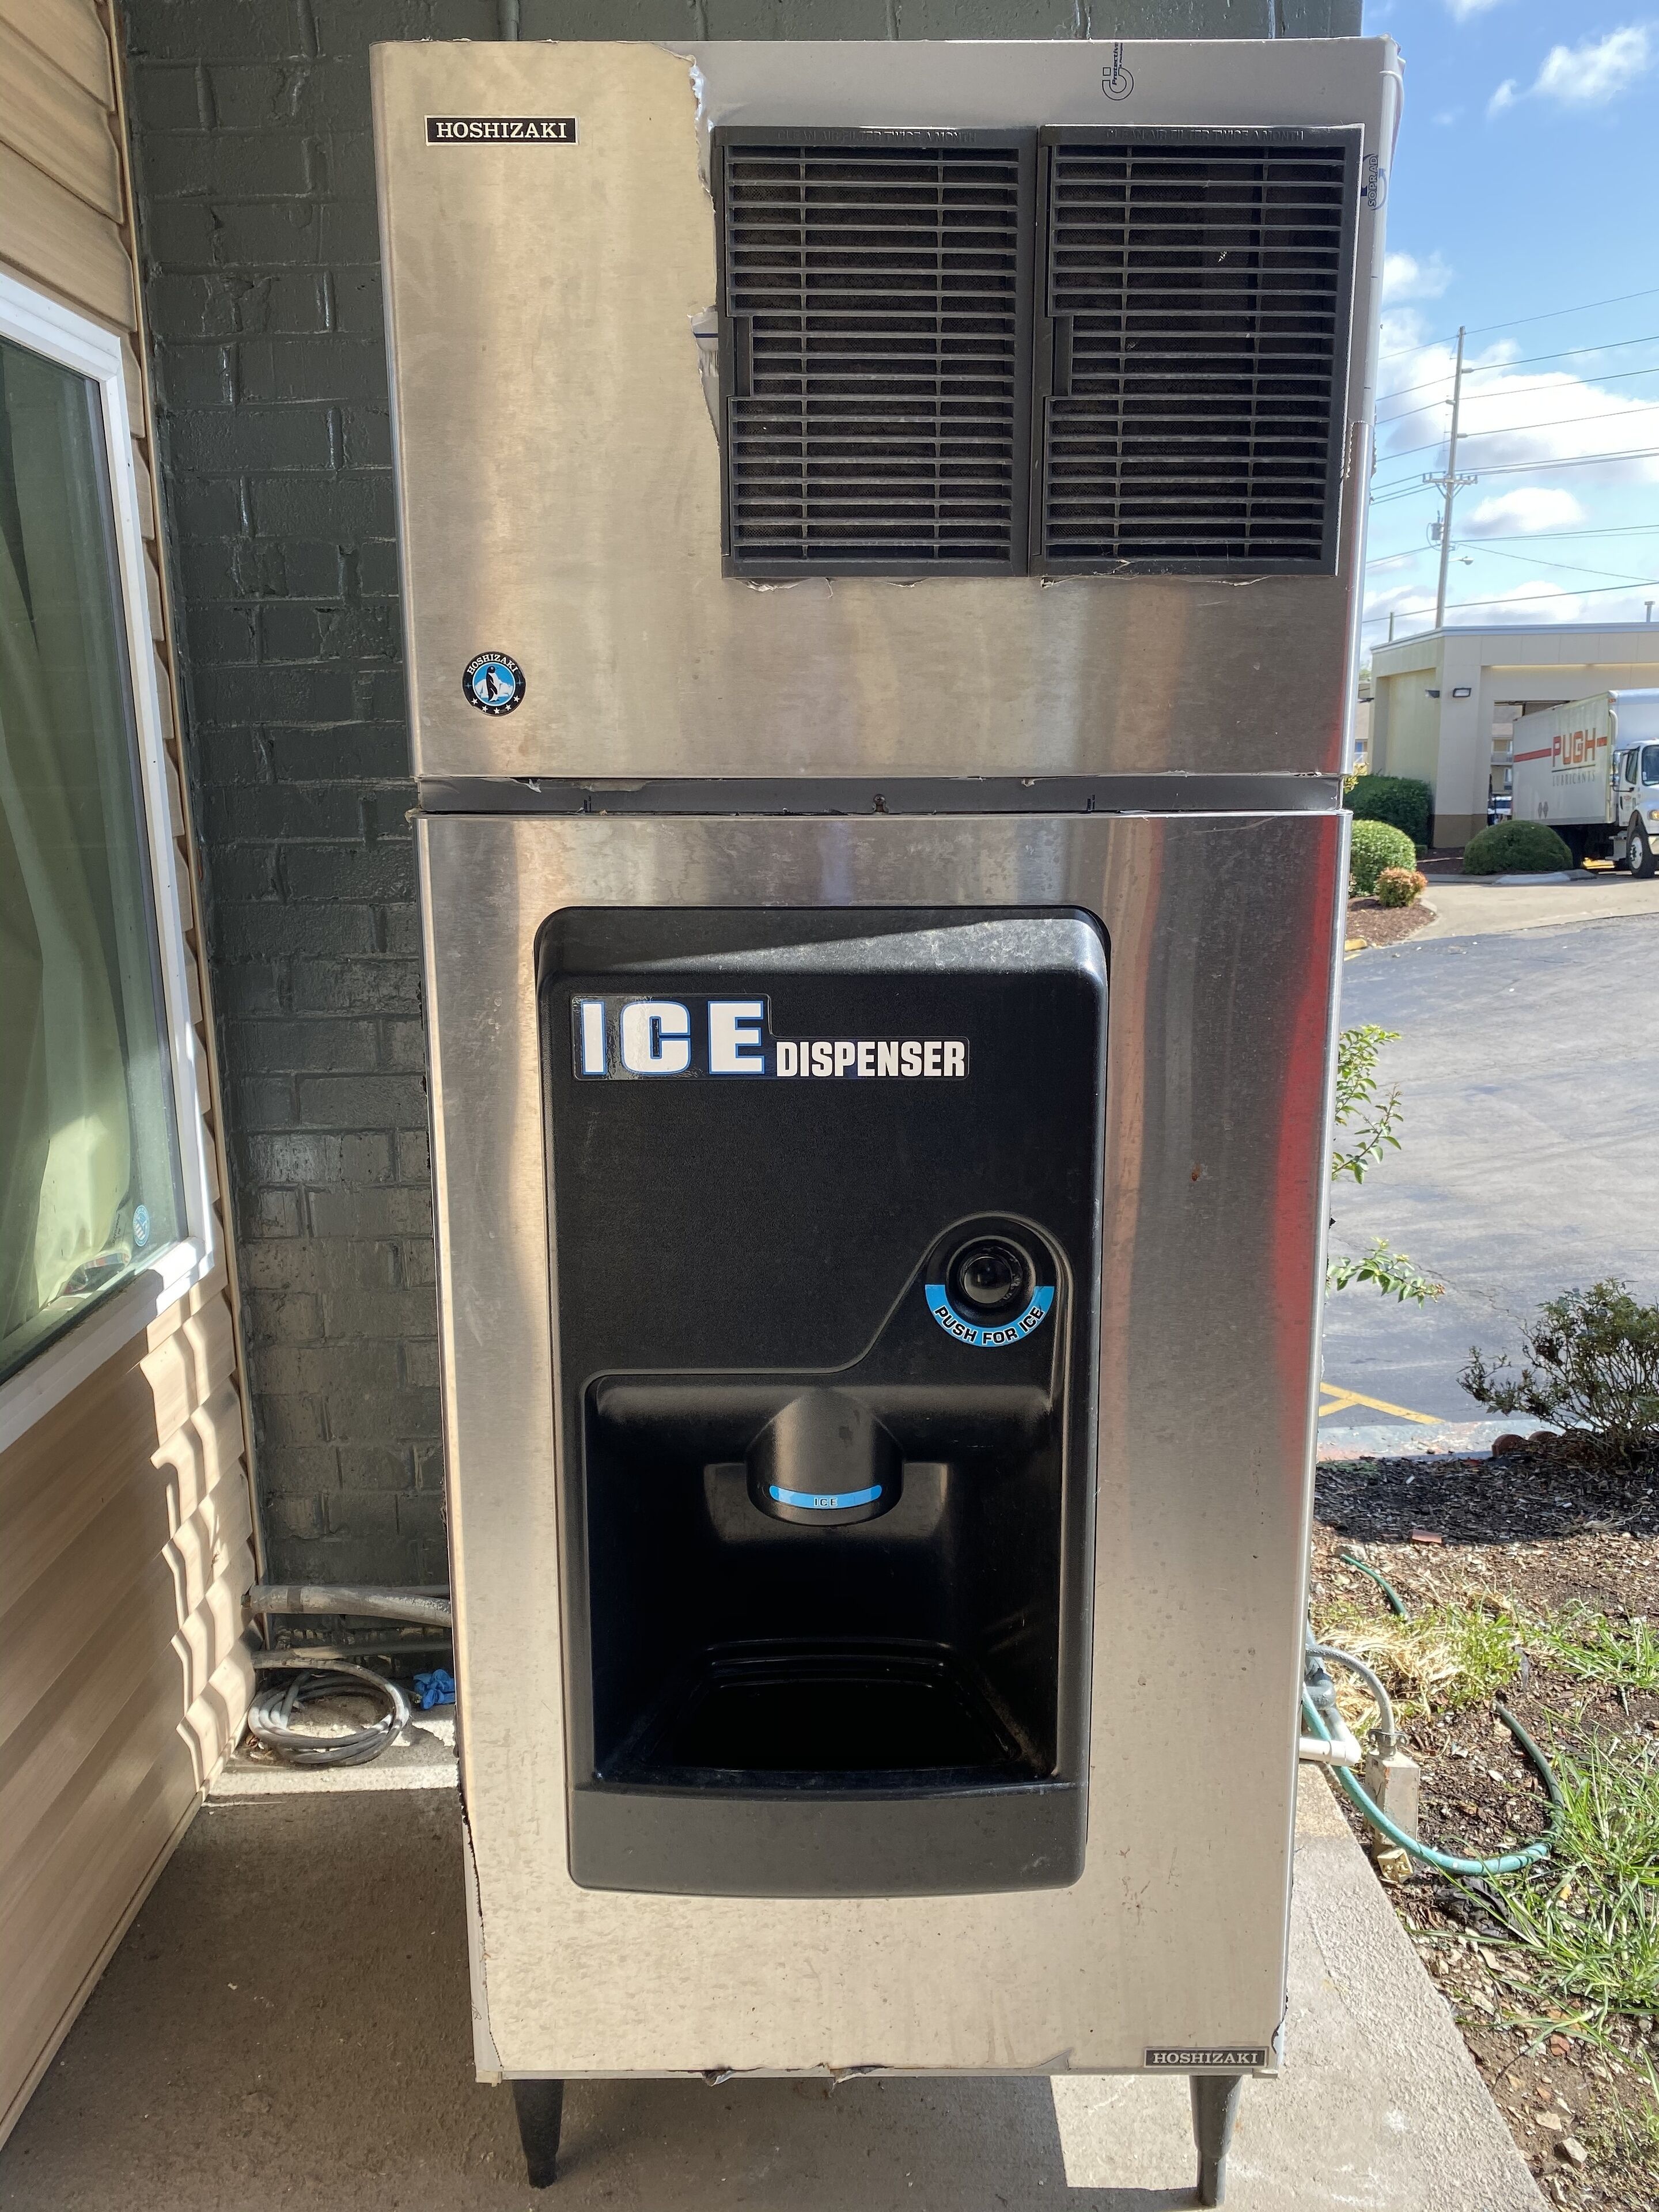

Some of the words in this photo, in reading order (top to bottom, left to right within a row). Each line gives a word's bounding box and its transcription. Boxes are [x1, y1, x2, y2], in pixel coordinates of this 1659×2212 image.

[435, 122, 567, 138] HOSHIZAKI
[1212, 130, 1249, 141] TWICE
[1263, 130, 1304, 141] MONTH
[467, 653, 518, 675] HOSHIZAKI
[1552, 728, 1596, 767] PUGH
[1552, 770, 1595, 787] LUBRICANTS
[582, 1000, 765, 1075] ICE
[776, 1041, 965, 1077] DISPENSER
[934, 1305, 978, 1343] PUSH
[982, 1327, 1018, 1346] FOR
[1018, 1306, 1046, 1334] ICE
[813, 1497, 838, 1507] ICE
[1153, 2052, 1258, 2064] HOSHIZAKI
